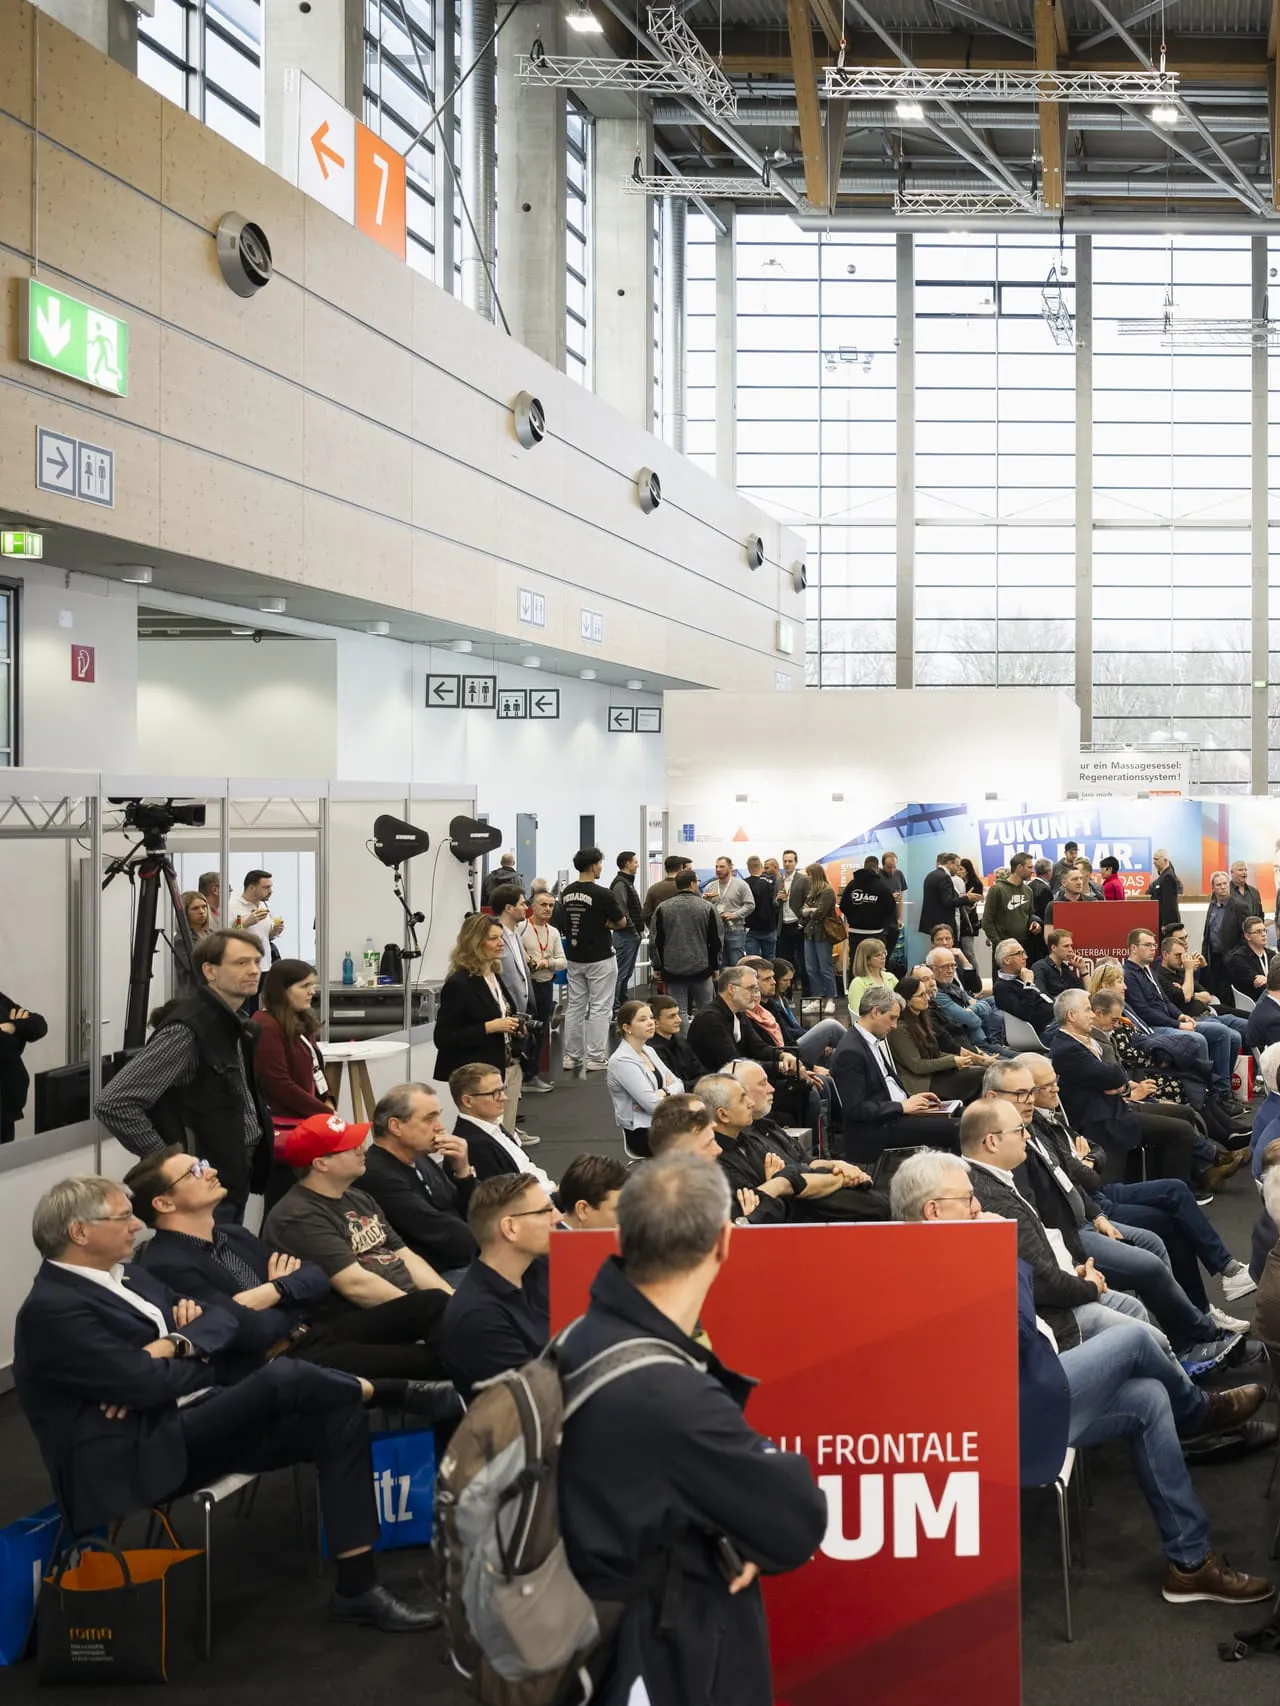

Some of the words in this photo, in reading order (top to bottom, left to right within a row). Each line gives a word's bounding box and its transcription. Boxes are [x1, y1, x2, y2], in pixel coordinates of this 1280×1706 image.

[373, 153, 388, 226] 7
[1080, 772, 1181, 783] Regenerationssystem!
[1093, 761, 1108, 769] ein
[1111, 761, 1182, 772] Massagesessel:
[985, 815, 1093, 846] ZUKUNFT
[818, 1432, 979, 1464] FRONTALE
[373, 1468, 413, 1524] itz
